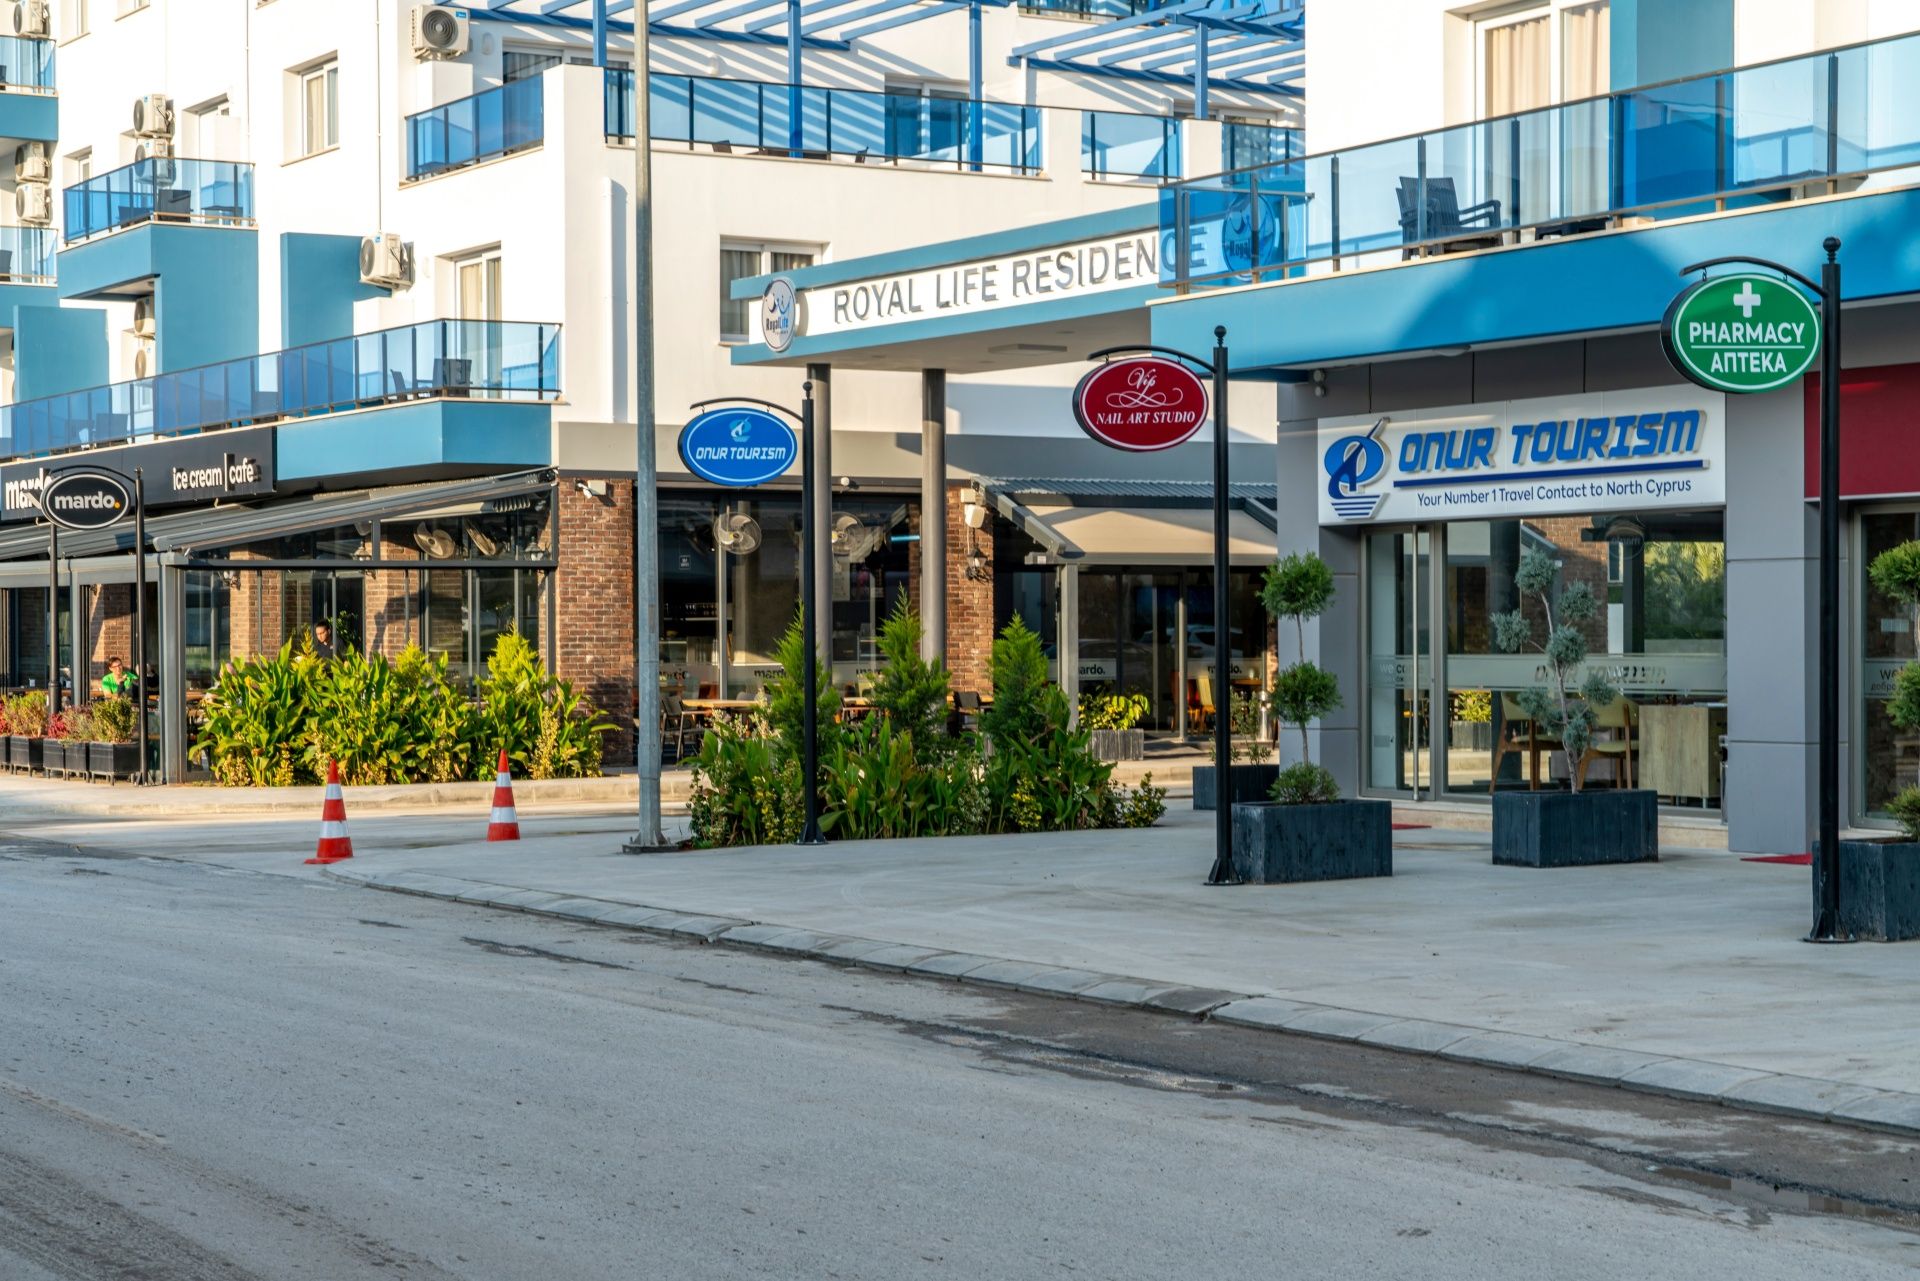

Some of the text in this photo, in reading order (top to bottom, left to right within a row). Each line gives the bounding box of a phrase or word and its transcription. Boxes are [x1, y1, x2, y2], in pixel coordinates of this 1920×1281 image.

[834, 226, 1208, 324] ROYAL LIFE RESIDENCE
[1689, 322, 1805, 343] PHARMACY
[1711, 352, 1787, 373] АПТЕКА
[1096, 410, 1196, 425] NAIL ART STUDIO
[695, 446, 786, 460] ONUR TOURISM
[1398, 409, 1703, 473] ONUR TOURISM
[173, 457, 254, 490] ice cream cafe
[1418, 477, 1692, 507] Your Number 1 Travel Contact to North Cyprus
